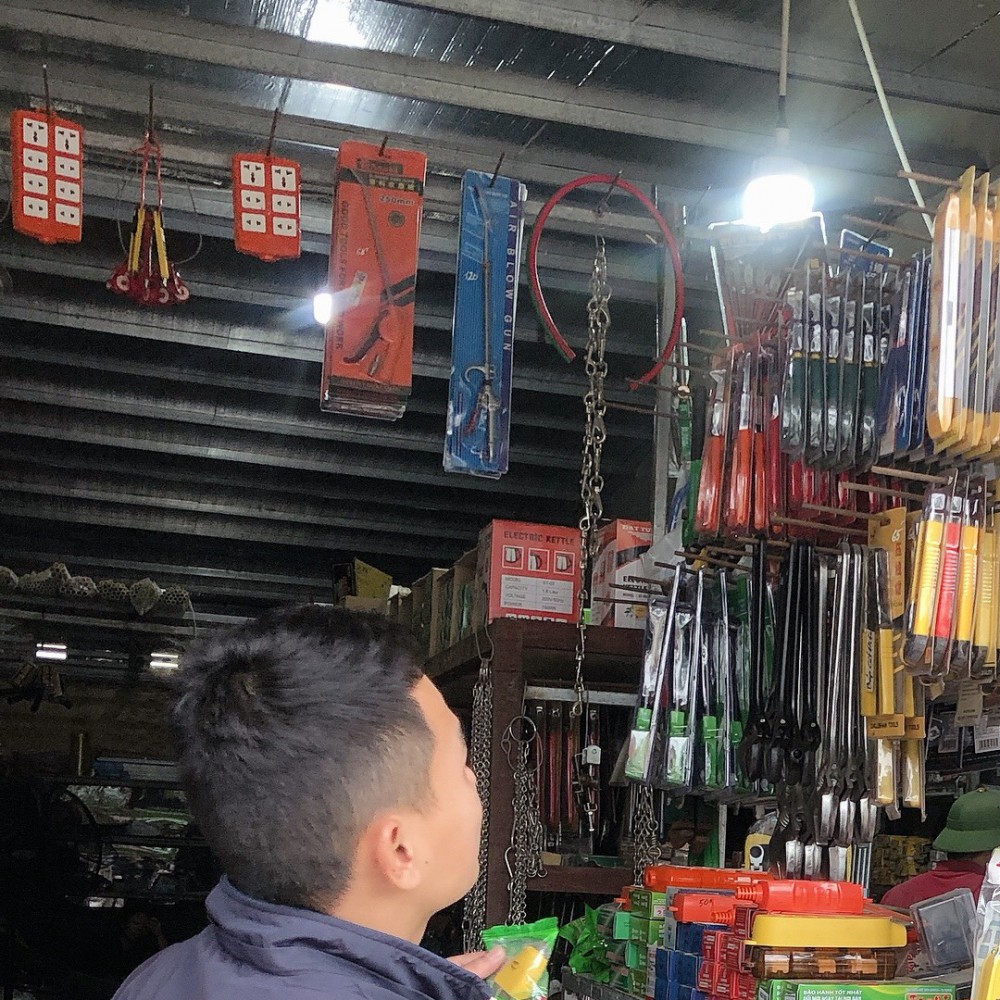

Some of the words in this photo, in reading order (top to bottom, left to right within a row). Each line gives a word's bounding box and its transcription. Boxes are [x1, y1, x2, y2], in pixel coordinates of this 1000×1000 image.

[508, 201, 518, 233] AIR
[505, 247, 516, 300] BLOW
[502, 315, 513, 351] GUN
[545, 535, 575, 546] KETTLE
